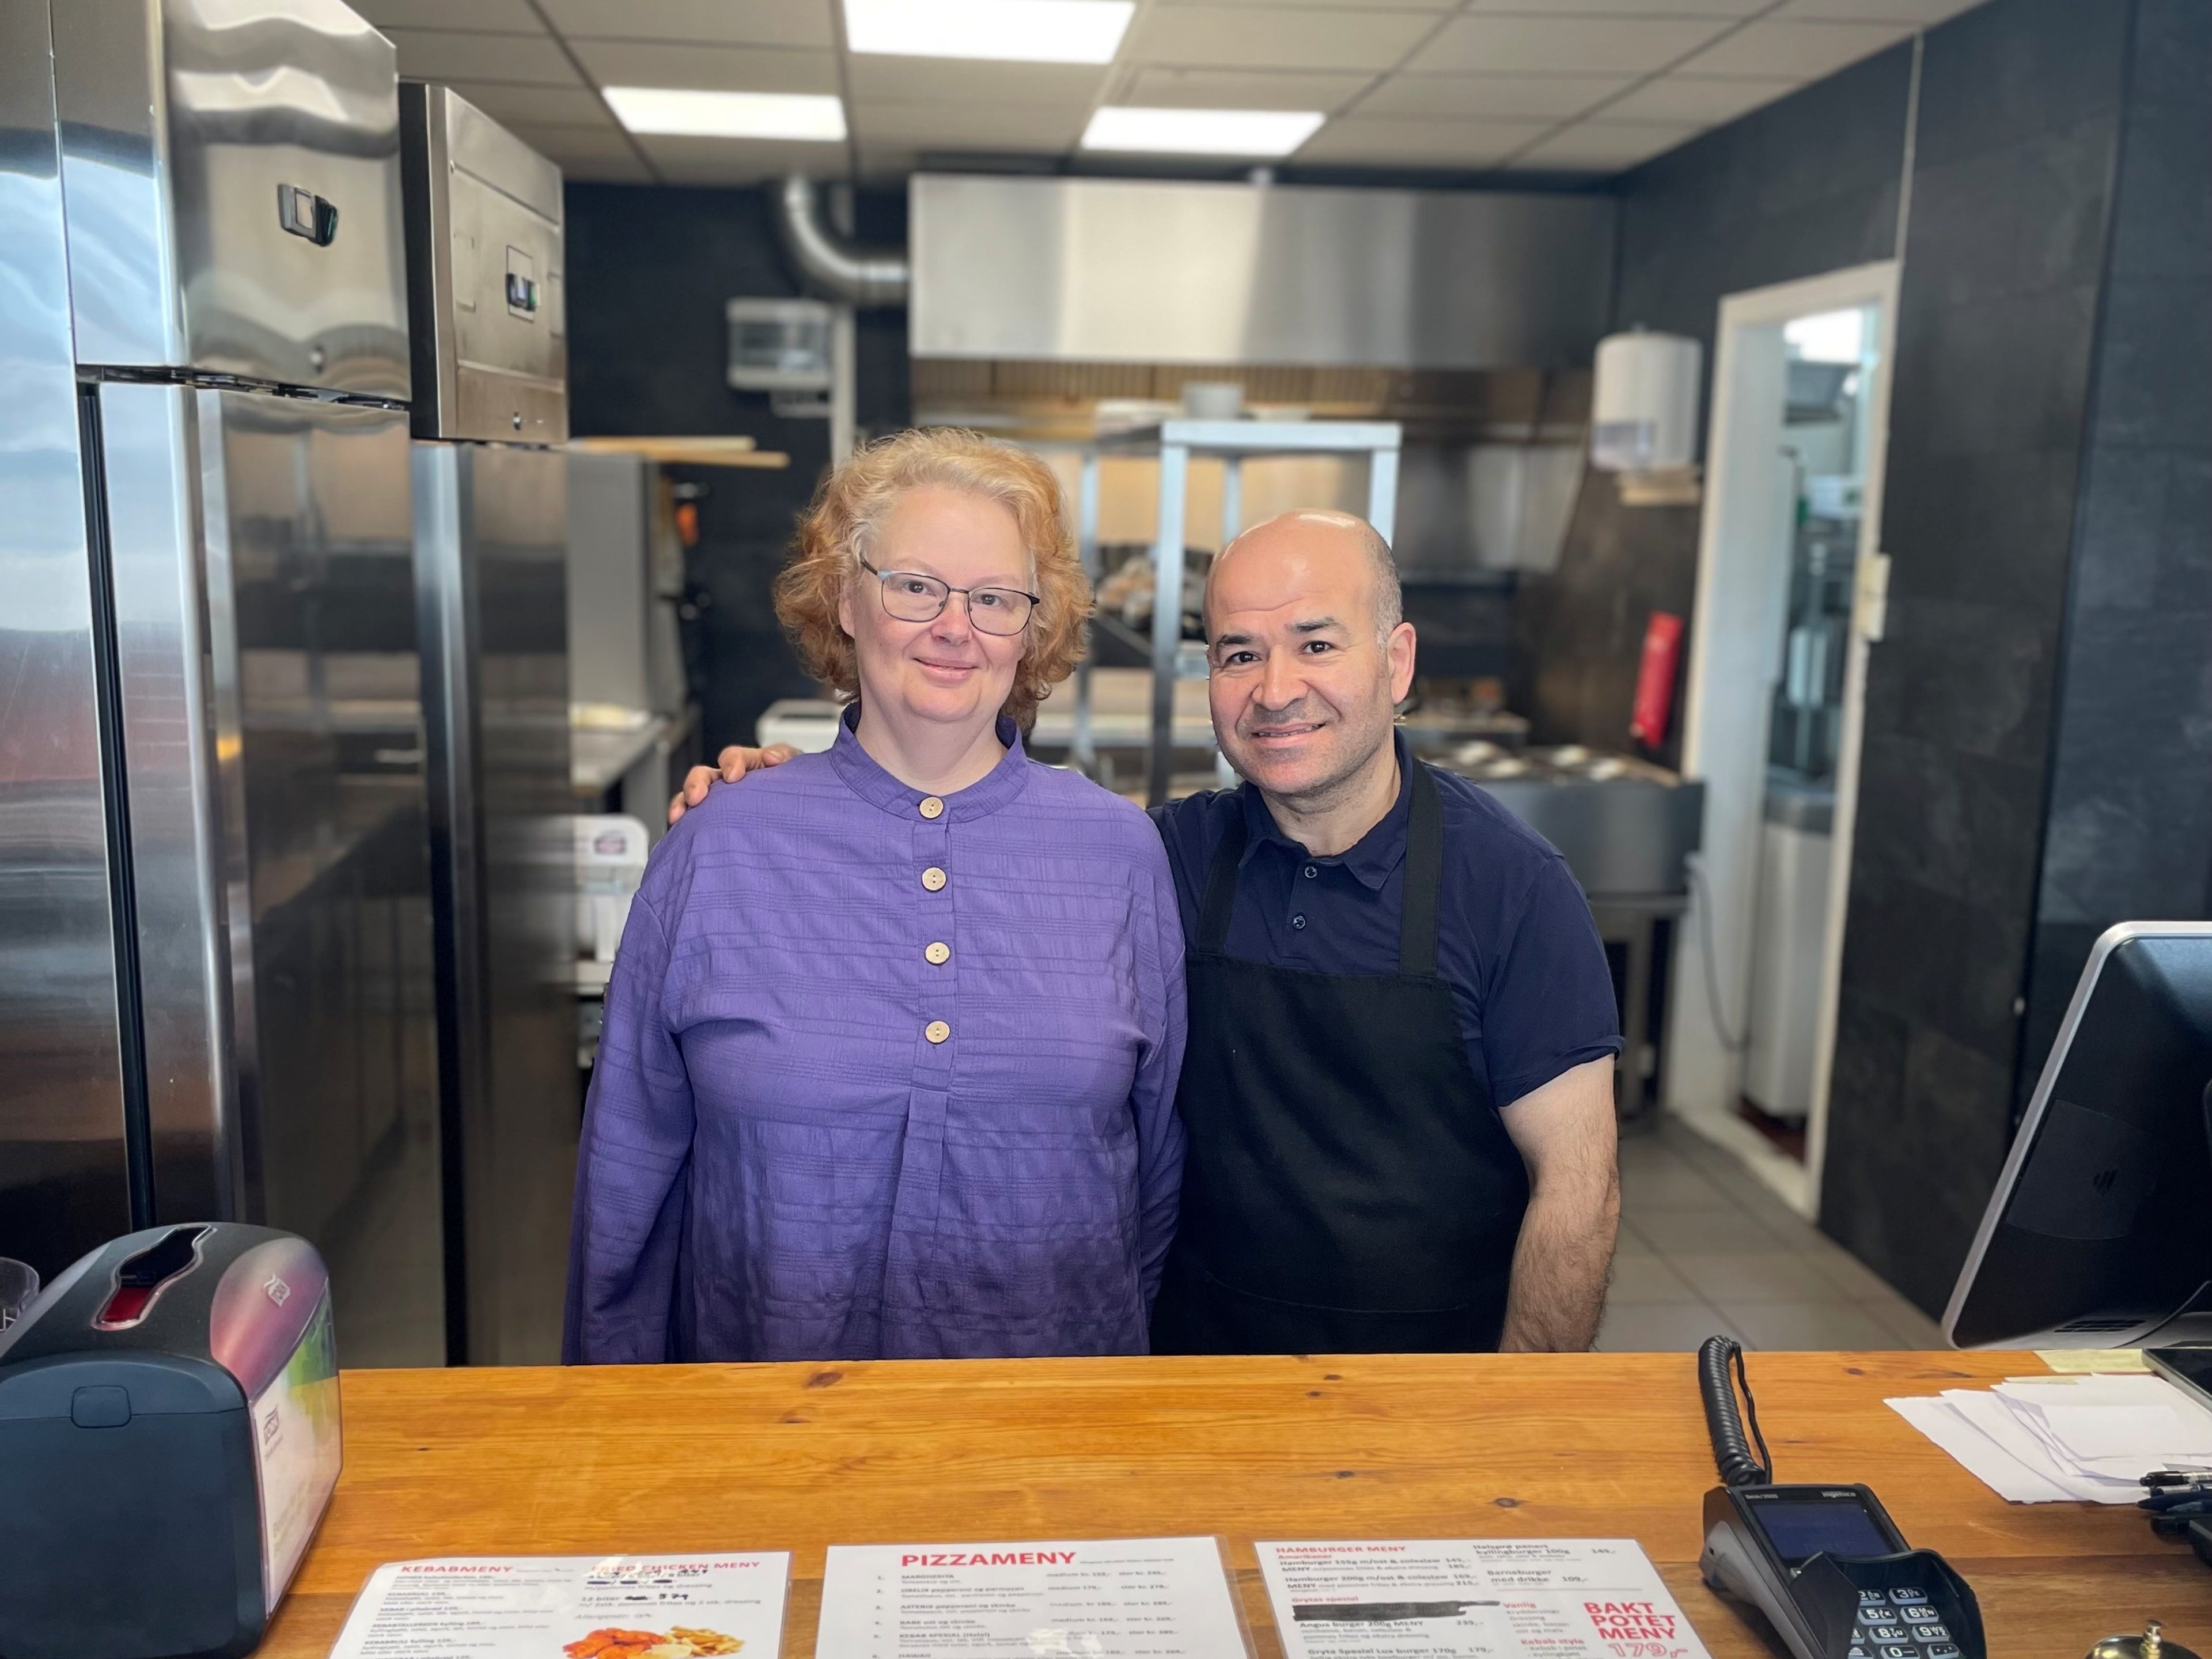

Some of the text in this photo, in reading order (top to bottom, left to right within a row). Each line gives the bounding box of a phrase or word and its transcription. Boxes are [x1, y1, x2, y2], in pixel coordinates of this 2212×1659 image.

[902, 1552, 1076, 1567] PIZZAMENY
[1897, 1589, 1909, 1599] 3
[1583, 1602, 1654, 1613] BAKT
[1866, 1609, 1879, 1619] 5
[1908, 1608, 1921, 1618] 6
[1590, 1615, 1675, 1627] POTET
[1598, 1627, 1675, 1639] MENY
[1878, 1628, 1891, 1638] 8
[1919, 1627, 1931, 1637] 9
[1608, 1642, 1689, 1658] 179,-
[1890, 1647, 1903, 1657] 0
